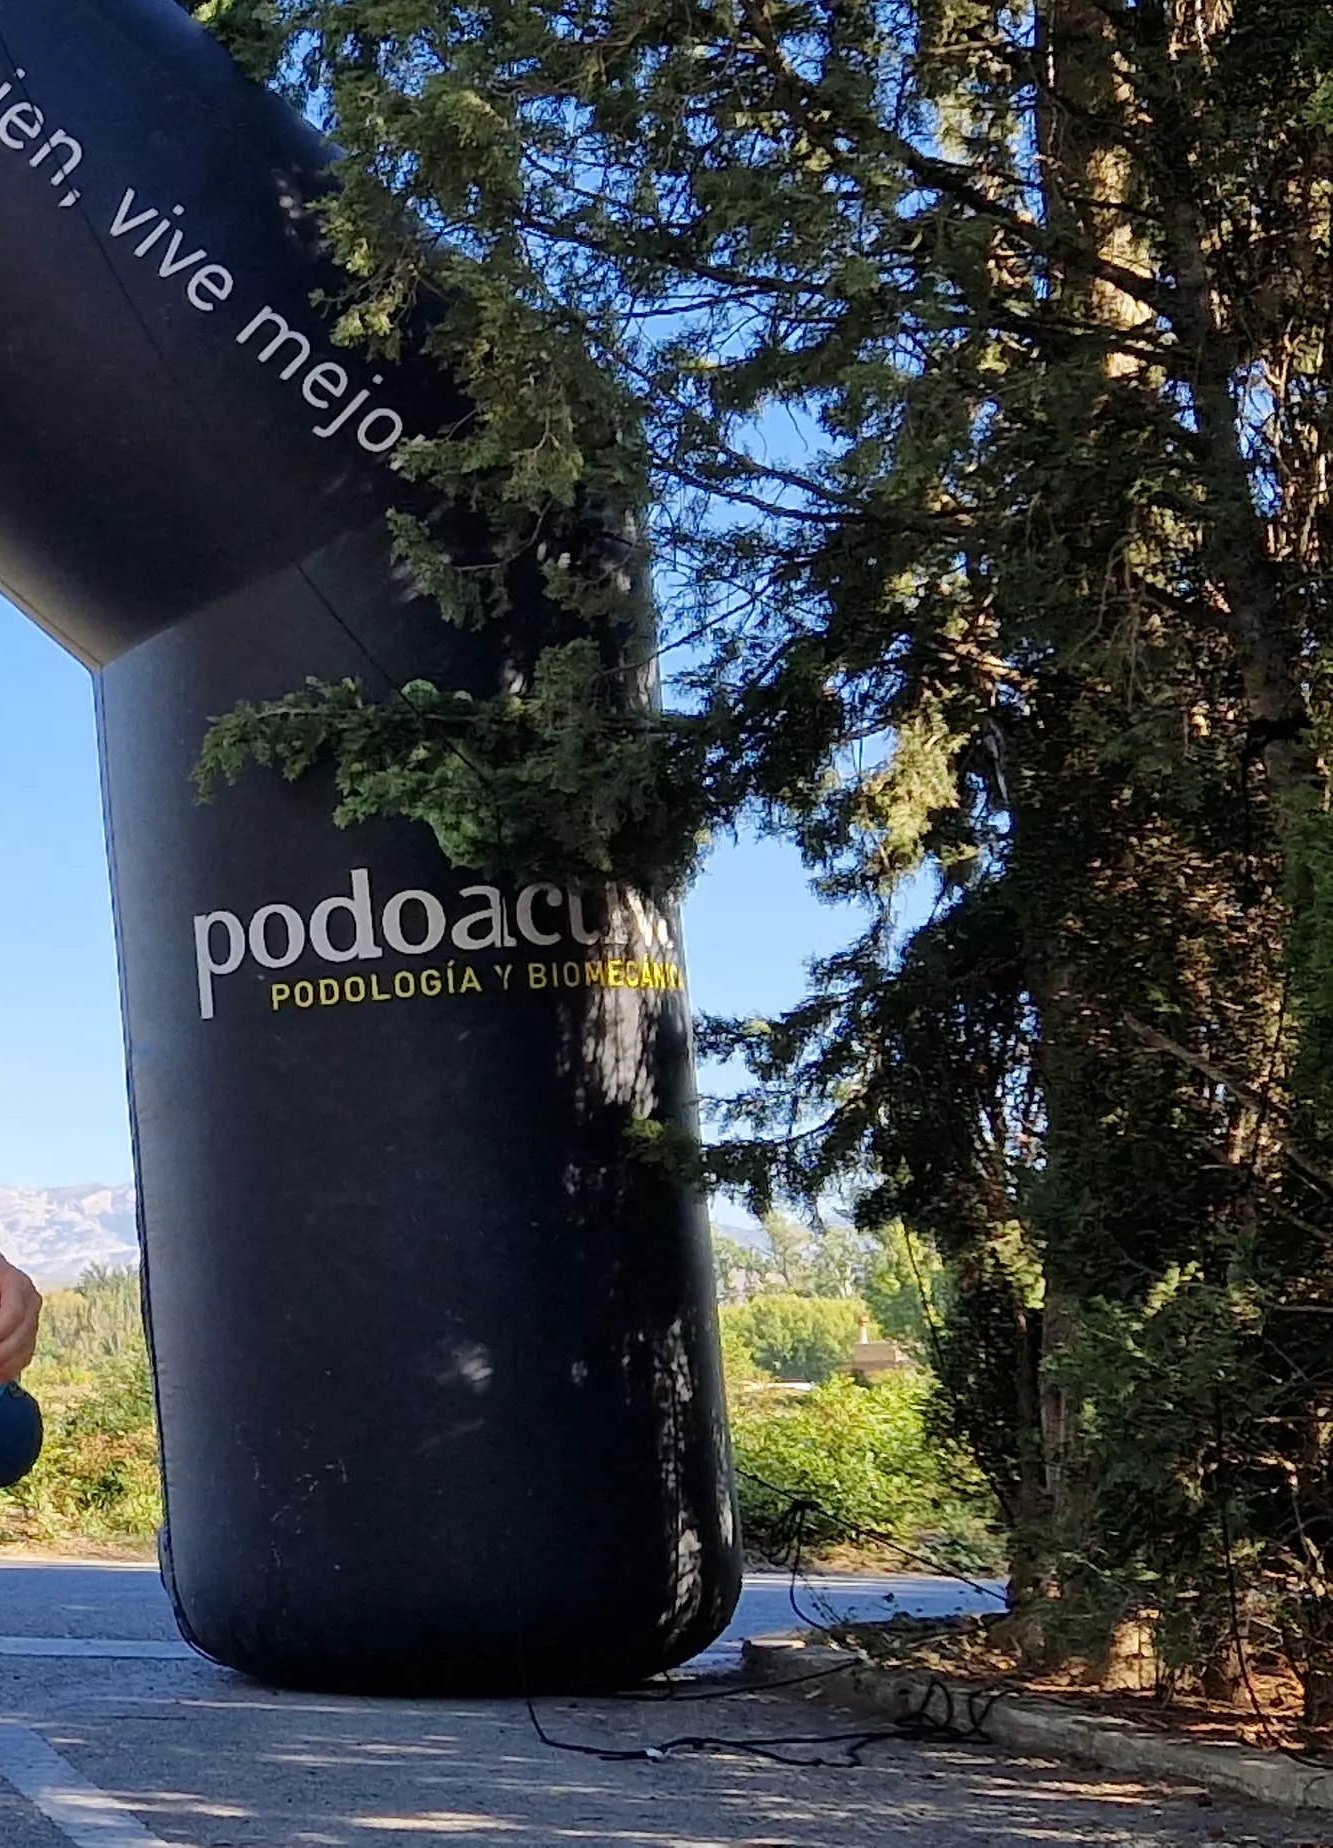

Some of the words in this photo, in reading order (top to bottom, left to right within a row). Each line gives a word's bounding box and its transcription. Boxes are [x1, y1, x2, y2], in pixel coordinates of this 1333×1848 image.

[108, 187, 234, 312] vive
[271, 959, 483, 1011] PODOLOGÍA
[495, 965, 512, 990] Y
